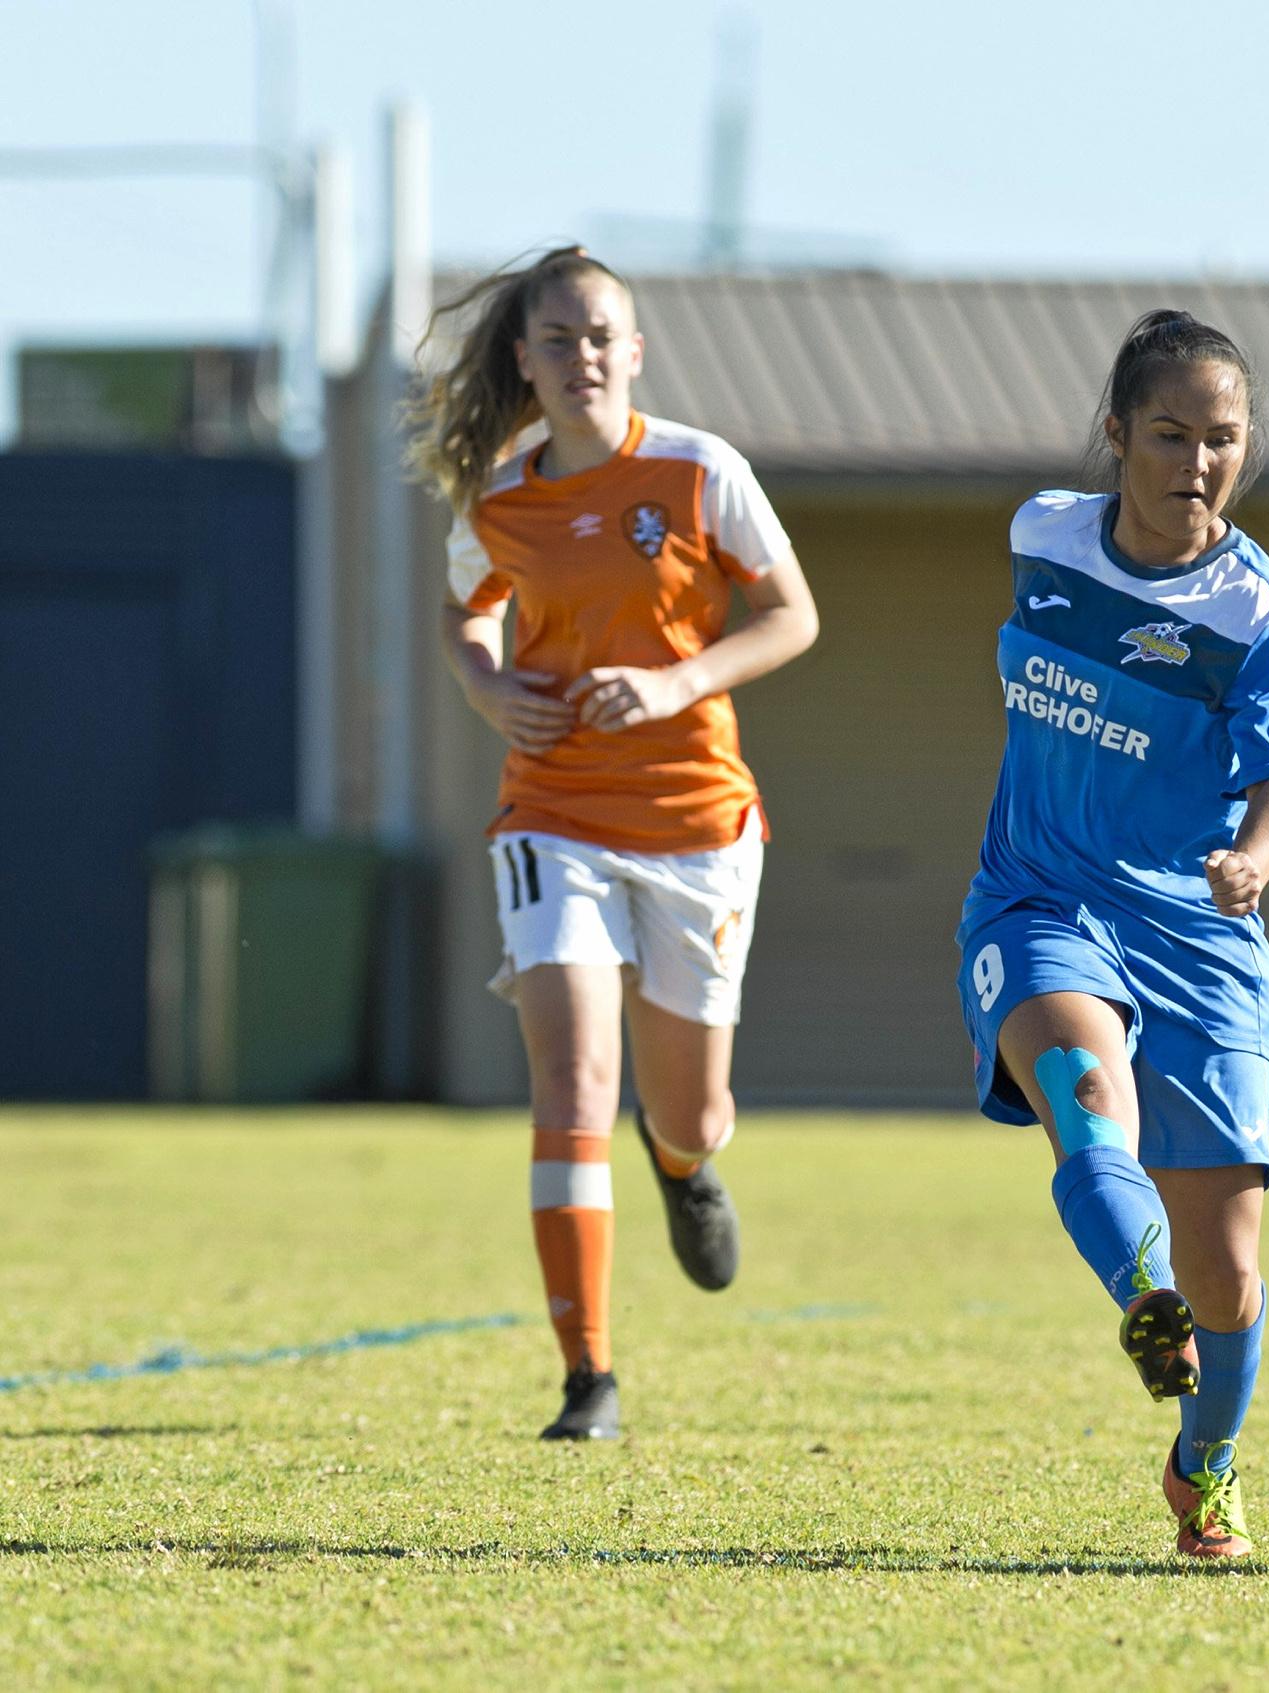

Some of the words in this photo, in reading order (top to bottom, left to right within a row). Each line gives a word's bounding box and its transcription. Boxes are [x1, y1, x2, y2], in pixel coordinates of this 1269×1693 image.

[1025, 656, 1098, 703] Clive
[1001, 676, 1150, 761] RGHOFER
[504, 837, 541, 911] 11
[973, 943, 1005, 1012] 9
